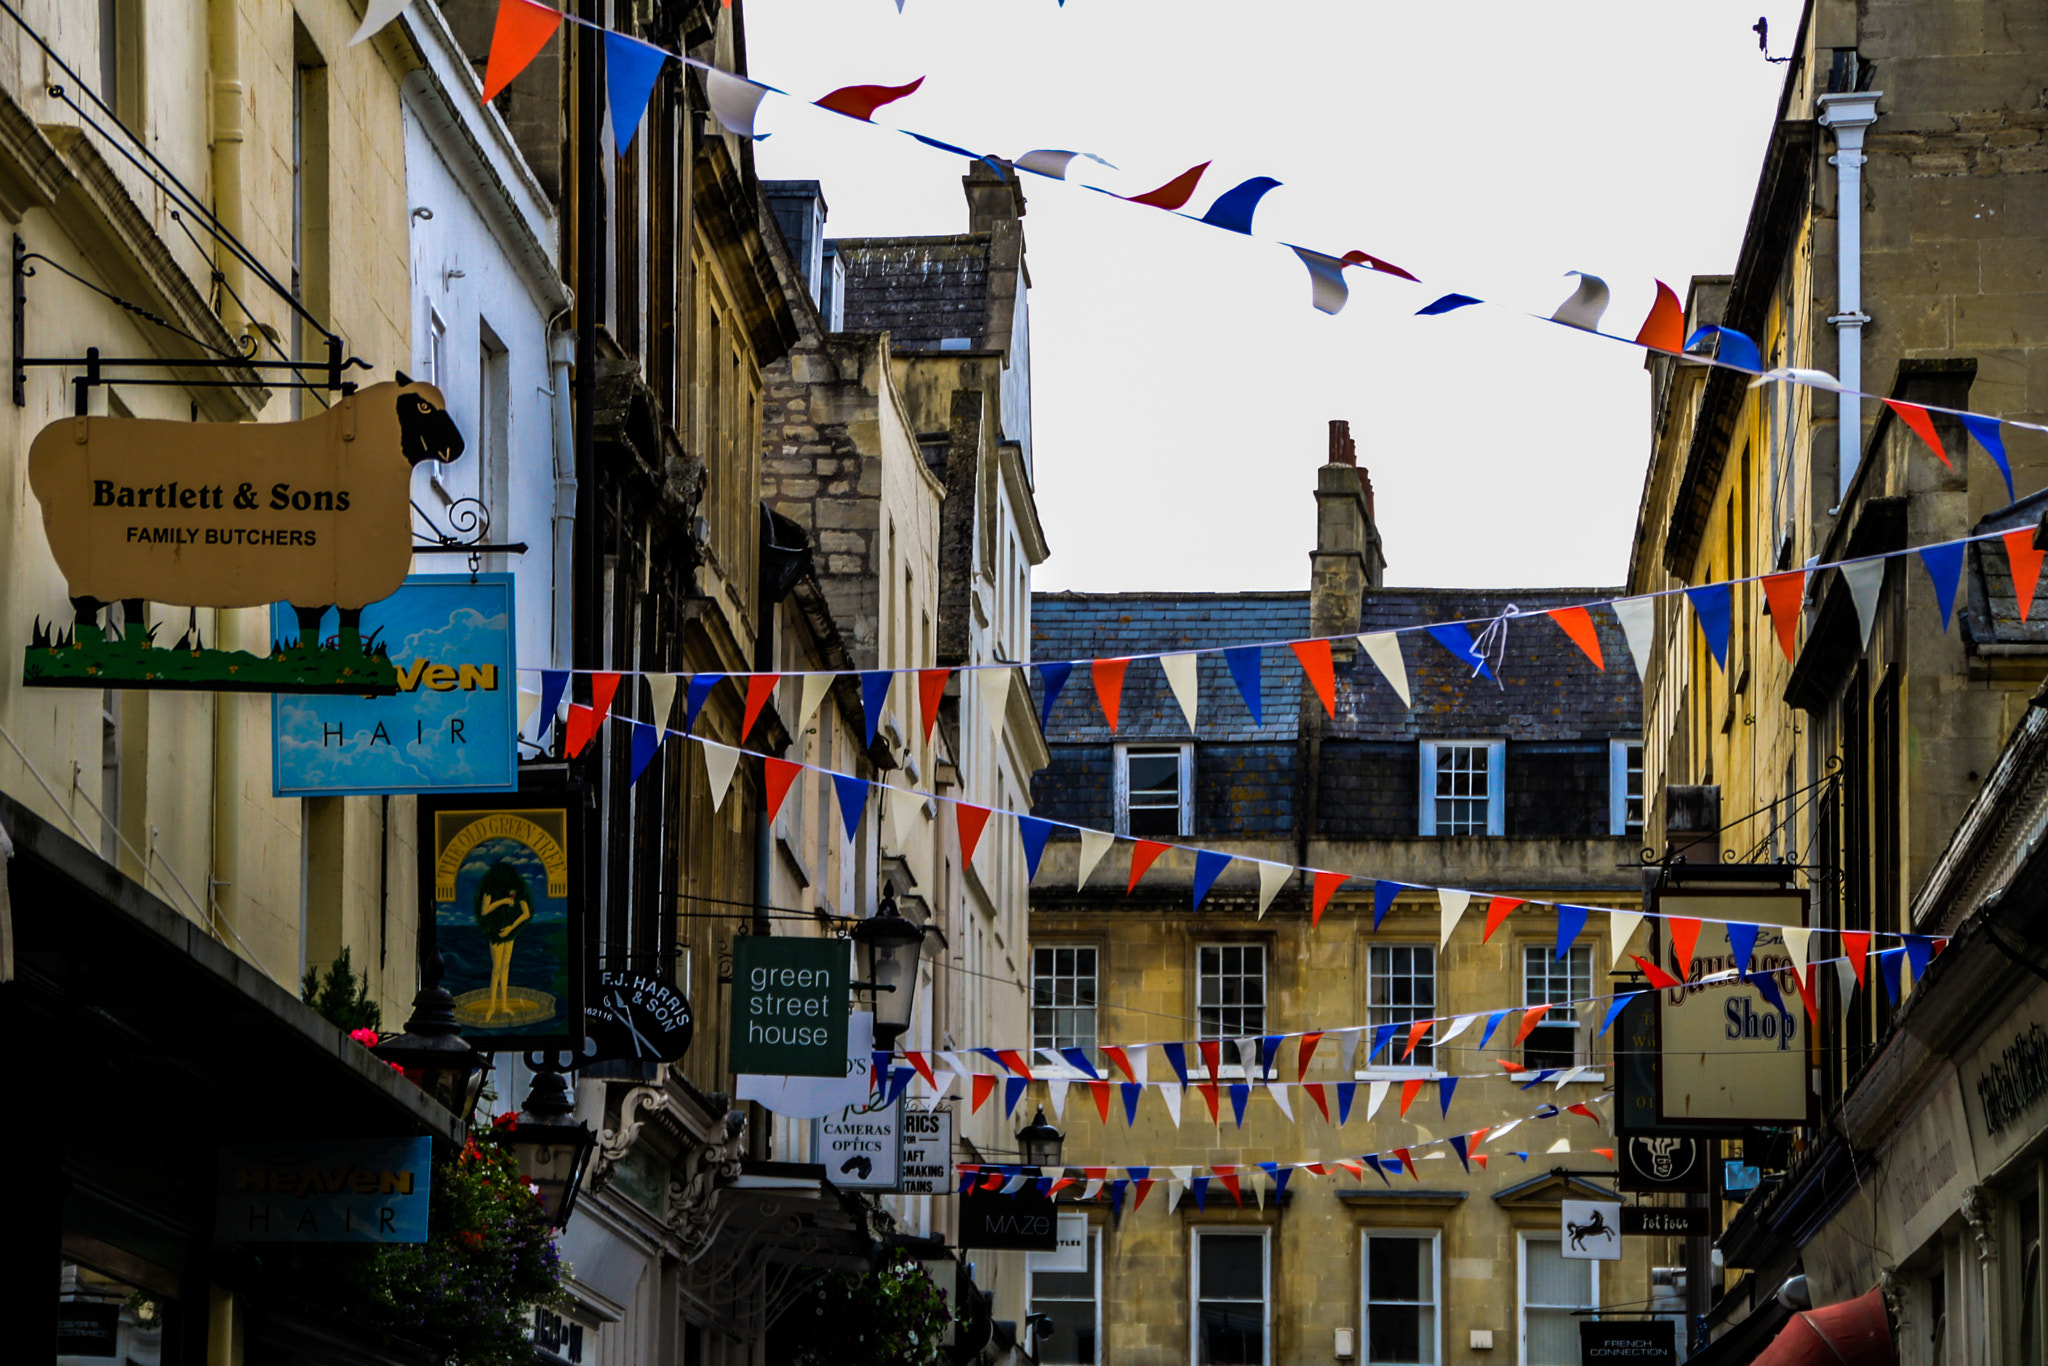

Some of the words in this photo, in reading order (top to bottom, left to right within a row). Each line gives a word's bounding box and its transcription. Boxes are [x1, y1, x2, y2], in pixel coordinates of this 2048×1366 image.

[93, 480, 224, 509] Bartlett
[233, 482, 260, 510] &
[269, 483, 351, 512] Sons
[126, 527, 200, 544] FAMILY
[205, 528, 317, 546] BUTCHERS
[323, 718, 467, 748] HAIR
[437, 843, 465, 879] THE
[457, 821, 488, 847] OLD
[489, 816, 537, 840] GREEN
[533, 831, 568, 875] TREE
[750, 967, 830, 992] green
[601, 971, 628, 987] F.J.
[633, 975, 690, 1027] HARRIS
[749, 993, 830, 1018] street
[631, 991, 643, 1005] &
[646, 998, 677, 1033] SON
[1723, 995, 1798, 1052] Shop
[748, 1020, 829, 1047] house
[823, 1123, 892, 1136] CAMERAS
[904, 1114, 940, 1134] RICS
[832, 1140, 882, 1152] OPTICS
[903, 1165, 945, 1178] MAKING
[903, 1180, 933, 1193] TAINS
[249, 1205, 396, 1233] HAIR
[1589, 1348, 1668, 1357] CONNECTION
[1603, 1340, 1653, 1348] FRENCH
